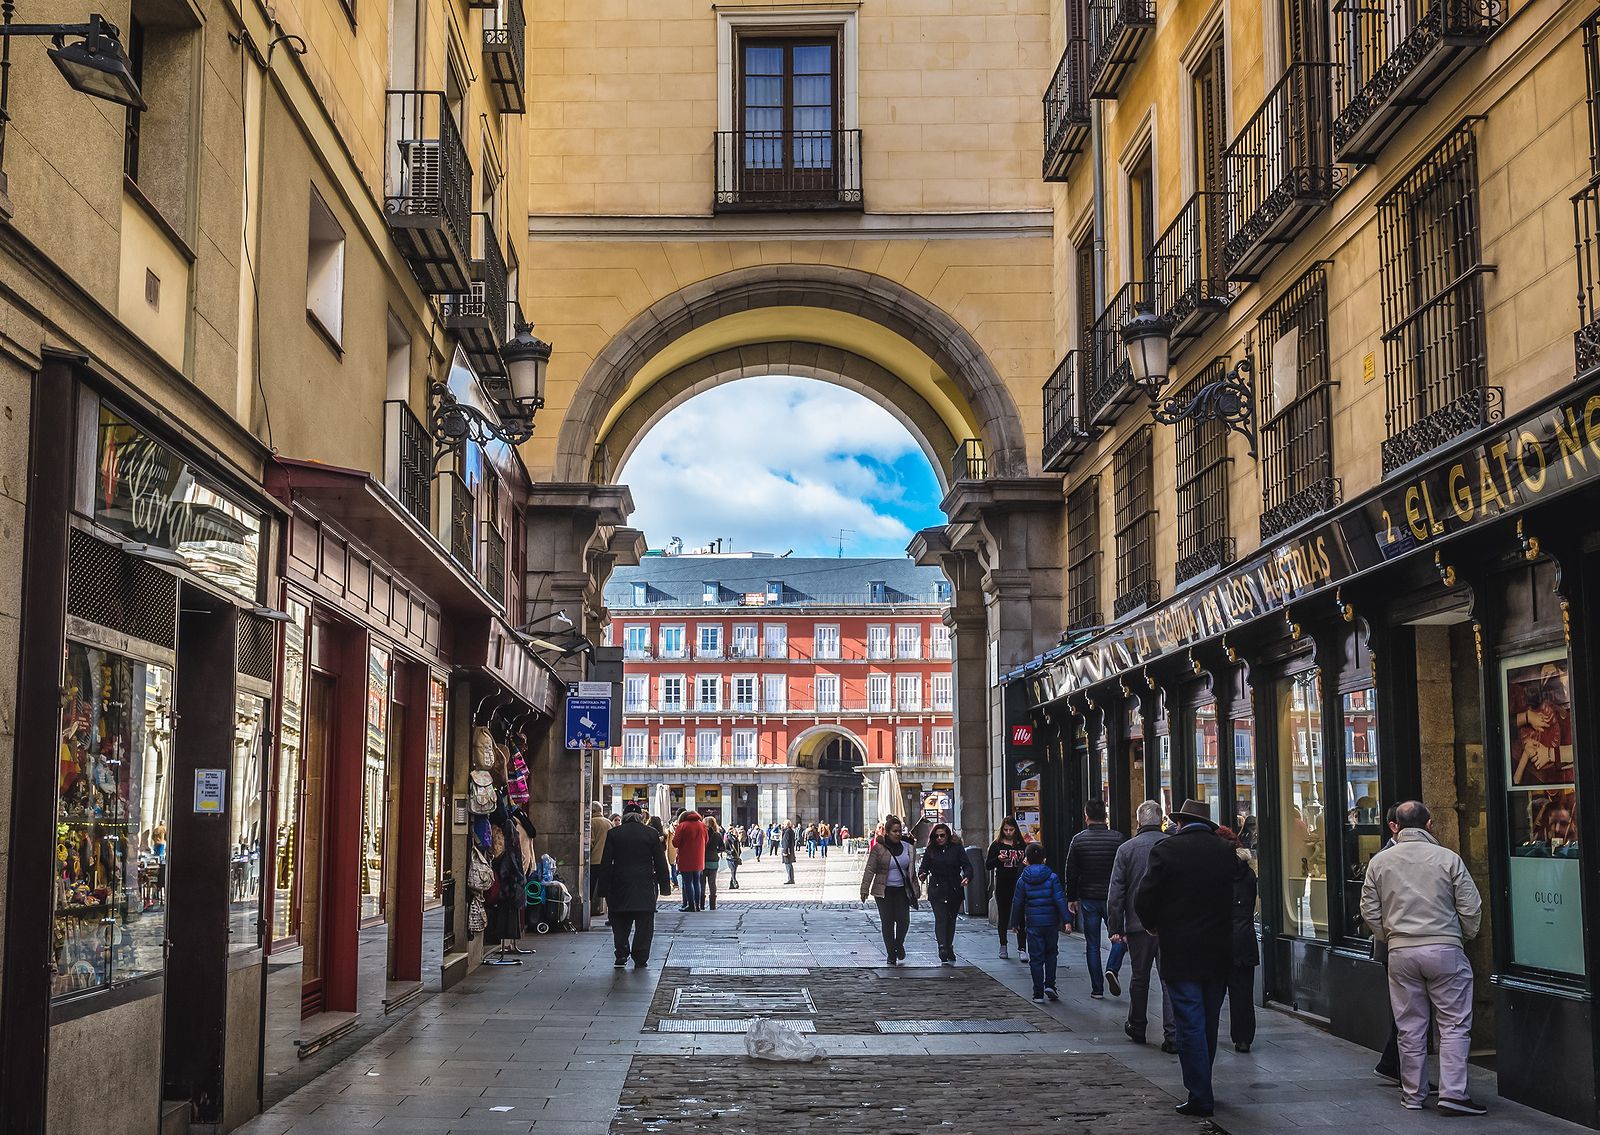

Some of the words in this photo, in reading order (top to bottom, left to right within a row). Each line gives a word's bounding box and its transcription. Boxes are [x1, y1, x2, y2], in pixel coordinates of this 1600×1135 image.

[1382, 510, 1396, 544] 2
[1405, 480, 1445, 541] EL
[1449, 431, 1547, 523] GATO
[1135, 627, 1152, 657] LA
[1154, 604, 1199, 648] ESQUINA
[1201, 590, 1222, 629] DE
[1226, 575, 1254, 617] LOS
[1258, 535, 1332, 603] AUSTRIAS
[1014, 728, 1031, 744] illy
[1534, 891, 1563, 905] GUCCI
